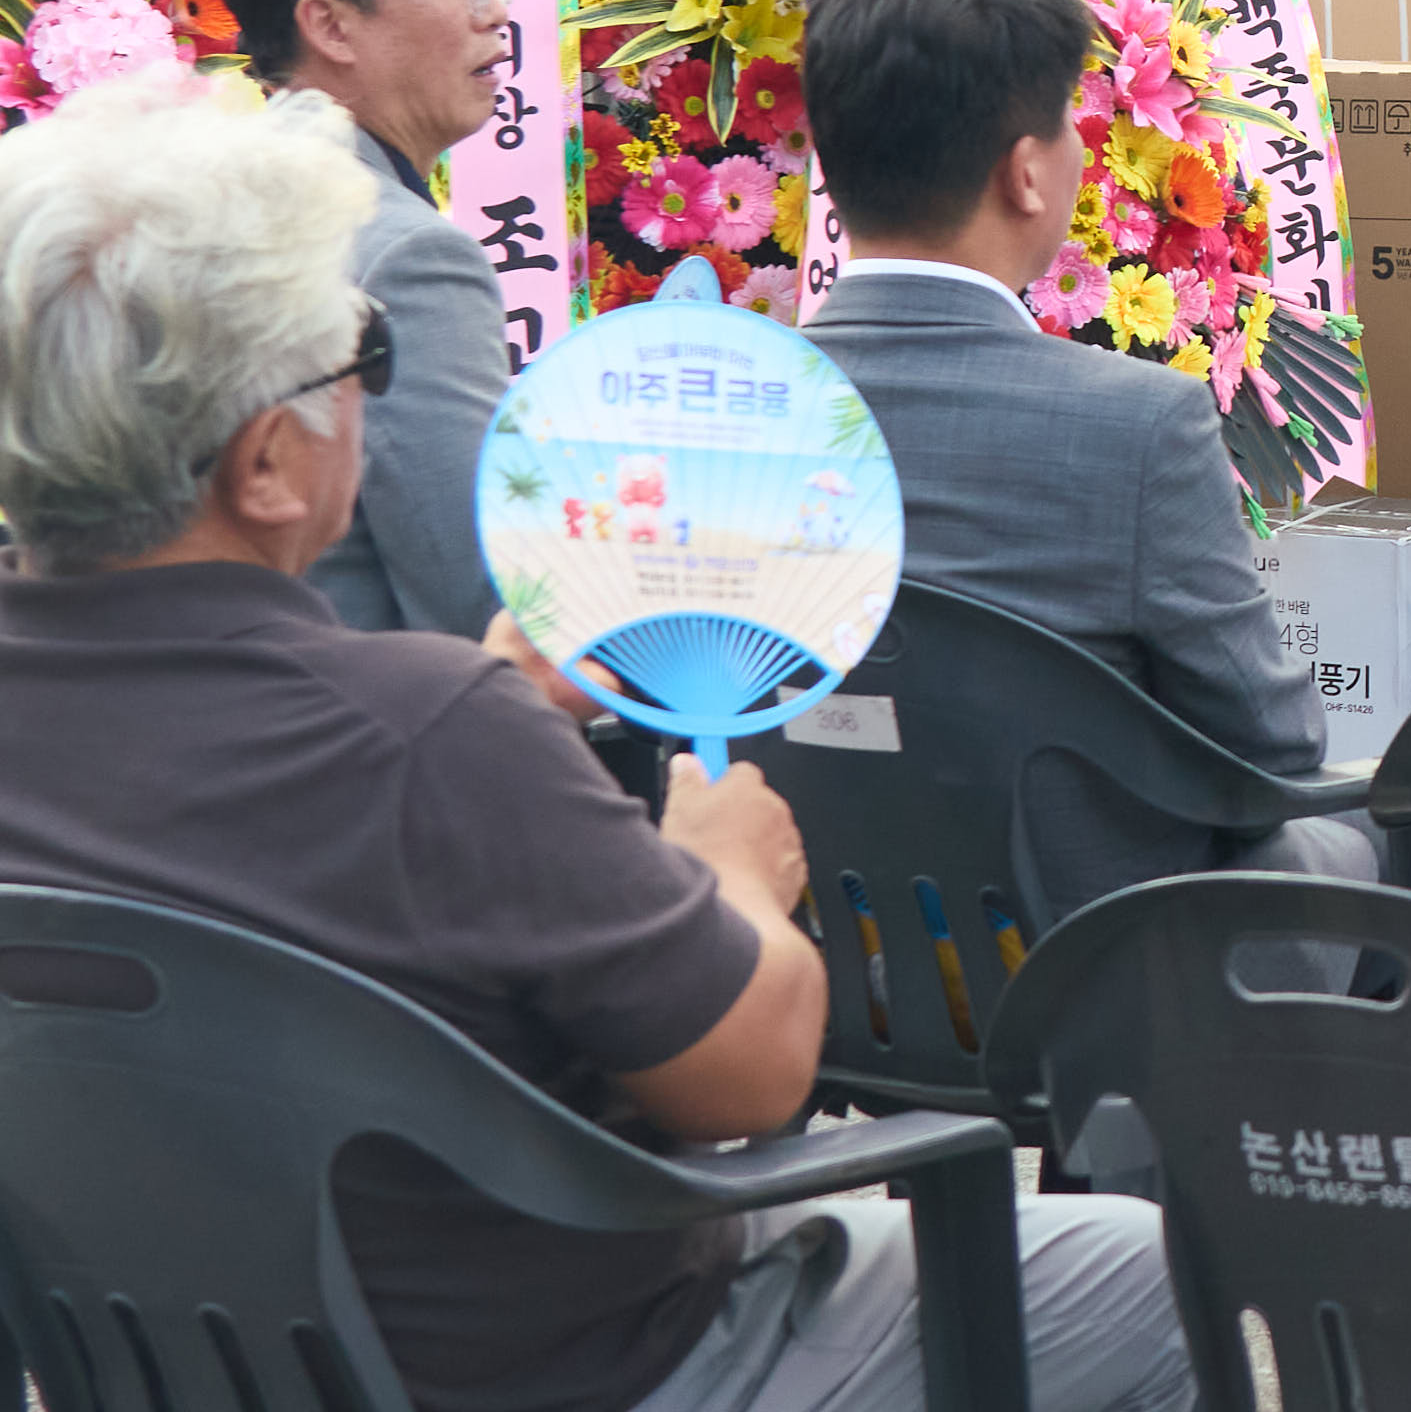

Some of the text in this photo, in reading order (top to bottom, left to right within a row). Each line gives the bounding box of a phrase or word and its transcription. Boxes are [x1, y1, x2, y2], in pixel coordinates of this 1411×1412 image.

[1372, 246, 1395, 280] 5
[602, 367, 790, 418] 아주 큰 금융
[1287, 599, 1310, 615] 바람
